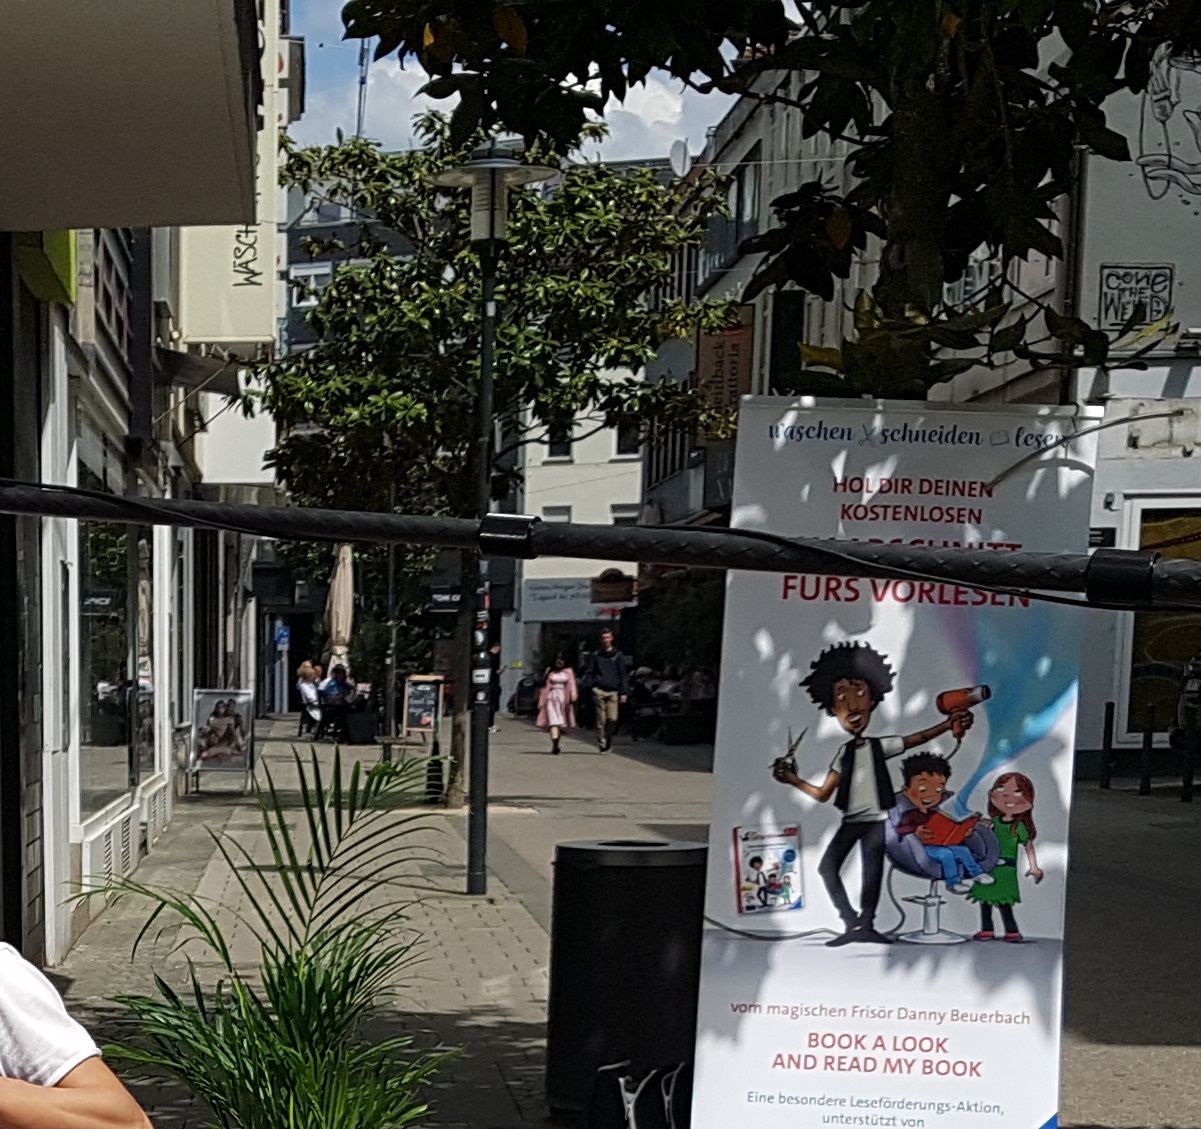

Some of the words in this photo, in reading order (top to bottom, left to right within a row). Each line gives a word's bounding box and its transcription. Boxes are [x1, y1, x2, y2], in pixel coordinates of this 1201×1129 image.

[1118, 286, 1151, 299] THE
[768, 420, 852, 441] waschen
[880, 421, 982, 447] schneiden
[1014, 426, 1068, 449] lesen
[832, 477, 874, 495] HOL
[879, 478, 913, 496] DIR
[918, 479, 994, 499] DEINEN
[840, 503, 983, 526] KOSTENLOSEN
[730, 1002, 762, 1015] vom
[766, 1002, 847, 1020] magischen
[851, 1004, 894, 1020] Frisör
[897, 1007, 947, 1026] Danny
[950, 1008, 1031, 1025] Beuerbach
[807, 1032, 867, 1051] BOOK
[872, 1035, 887, 1052] A
[892, 1036, 949, 1053] LOOK
[772, 1053, 818, 1071] AND
[823, 1055, 878, 1073] READ
[882, 1058, 917, 1075] MY
[922, 1059, 983, 1078] BOOK
[747, 1091, 775, 1104] Eine
[778, 1093, 847, 1107] besondere
[850, 1095, 1005, 1116] Leseförderungs-Aktion,
[822, 1112, 898, 1128] unterstützt
[900, 1117, 926, 1129] von
